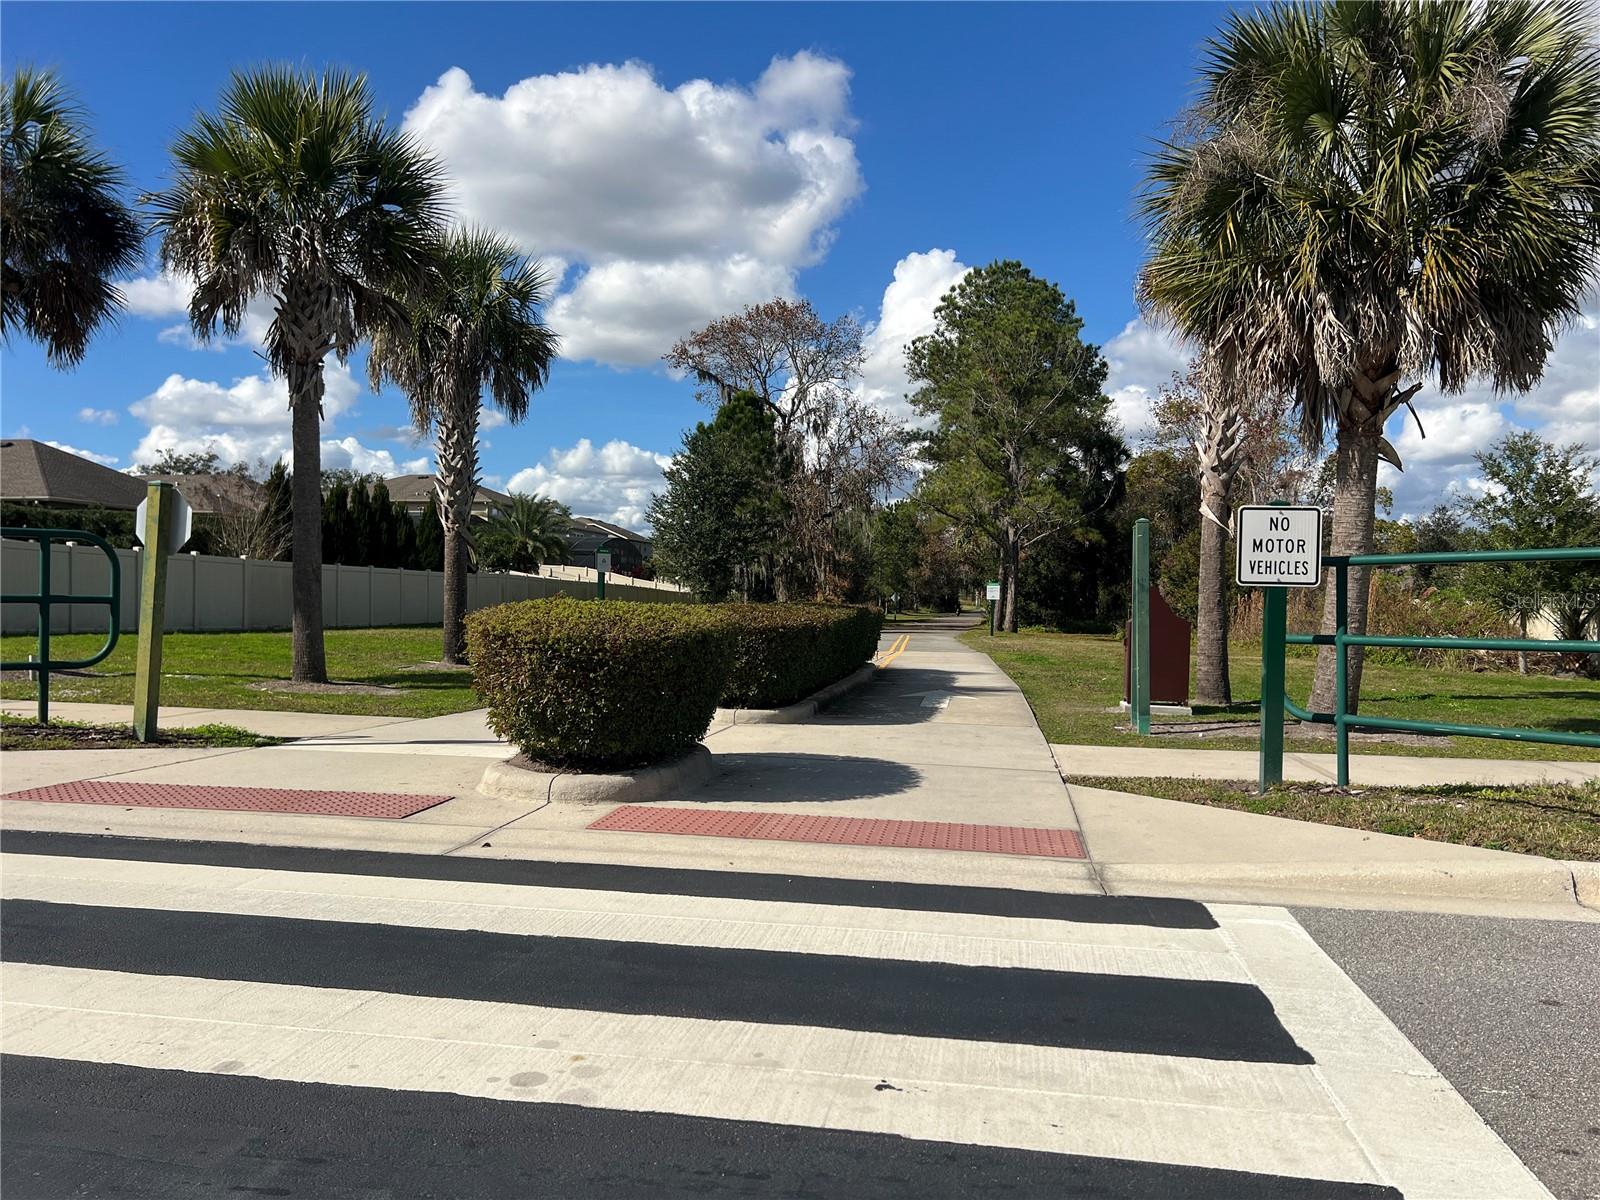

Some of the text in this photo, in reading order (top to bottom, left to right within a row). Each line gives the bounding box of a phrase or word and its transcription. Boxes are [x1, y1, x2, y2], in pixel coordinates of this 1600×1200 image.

[1270, 517, 1290, 531] NO
[1252, 538, 1306, 553] MOTOR
[1249, 560, 1309, 575] VEHICLES
